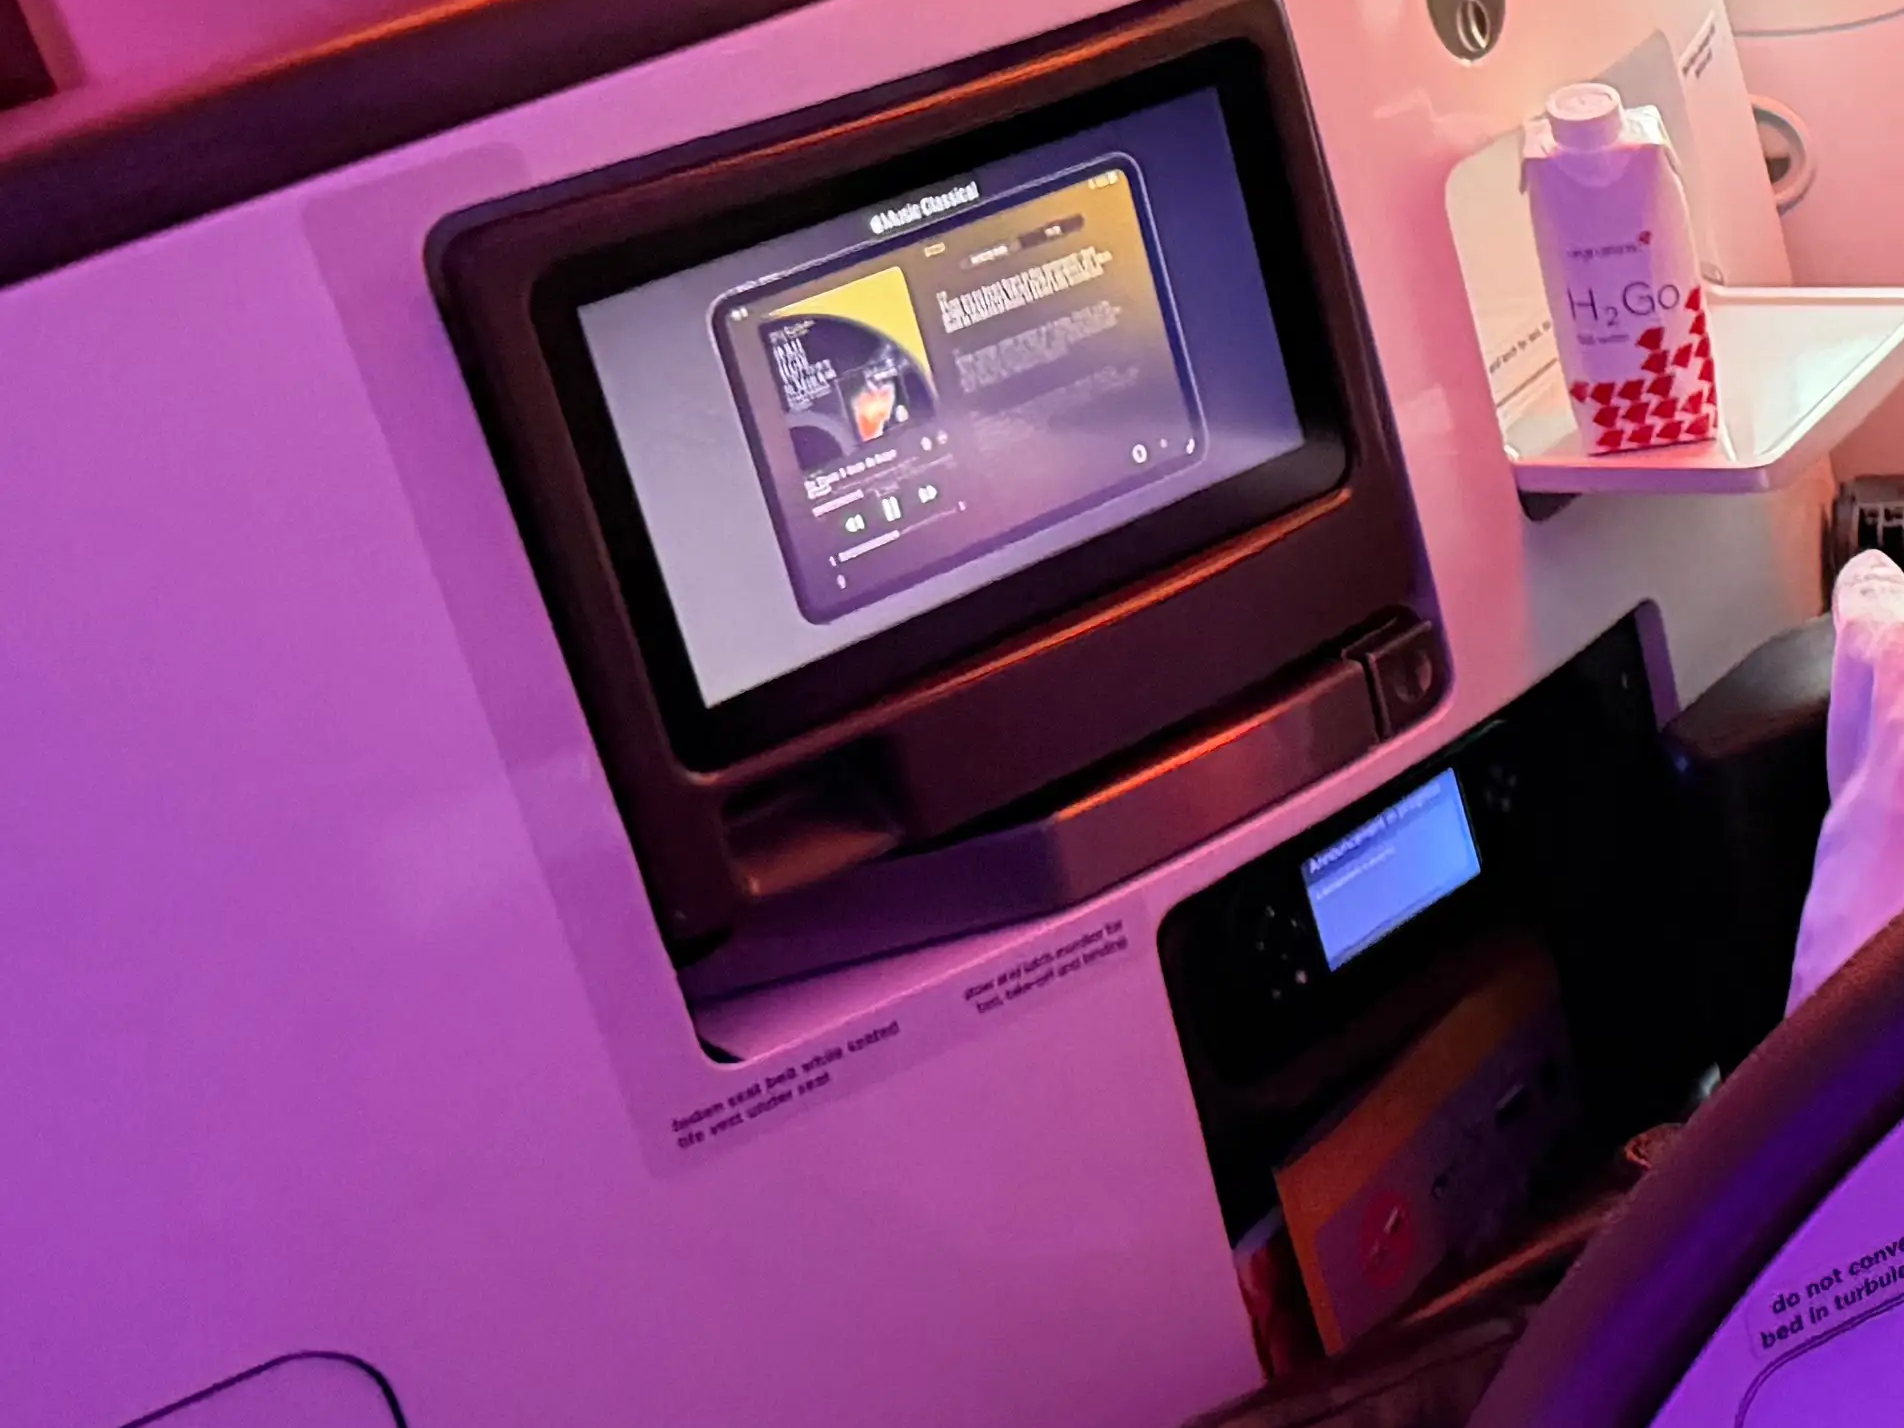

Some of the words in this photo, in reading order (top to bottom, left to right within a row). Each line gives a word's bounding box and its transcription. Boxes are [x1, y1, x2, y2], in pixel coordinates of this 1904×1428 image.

[1772, 1292, 1800, 1314] do
[1805, 1268, 1843, 1298] not
[1760, 1315, 1804, 1349] bed
[1808, 1305, 1829, 1324] in
